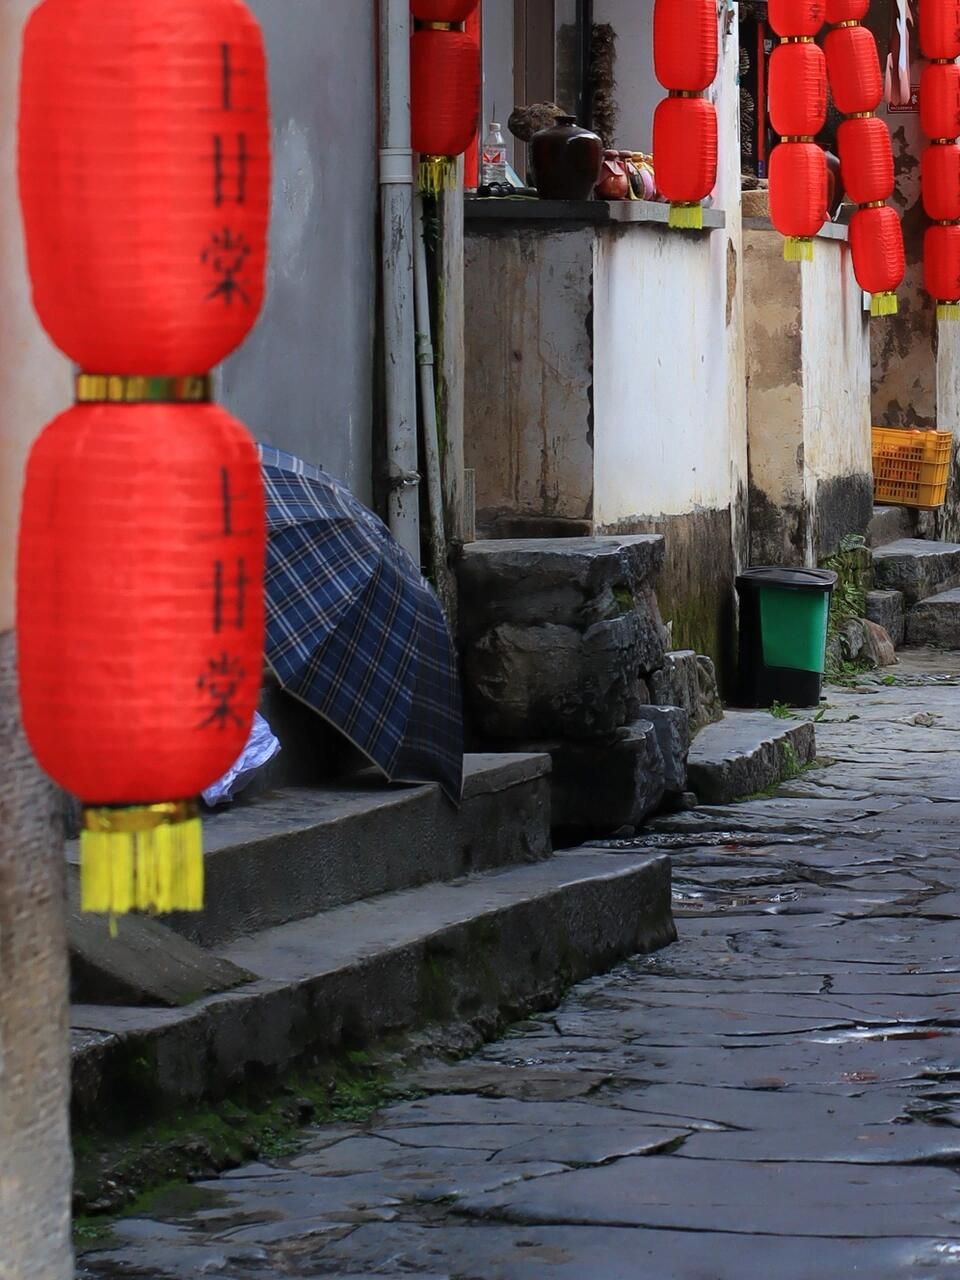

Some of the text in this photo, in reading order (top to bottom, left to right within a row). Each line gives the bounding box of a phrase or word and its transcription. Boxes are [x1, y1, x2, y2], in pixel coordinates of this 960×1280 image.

[200, 42, 255, 306] 上甘棠
[195, 465, 254, 730] 上甘棠
